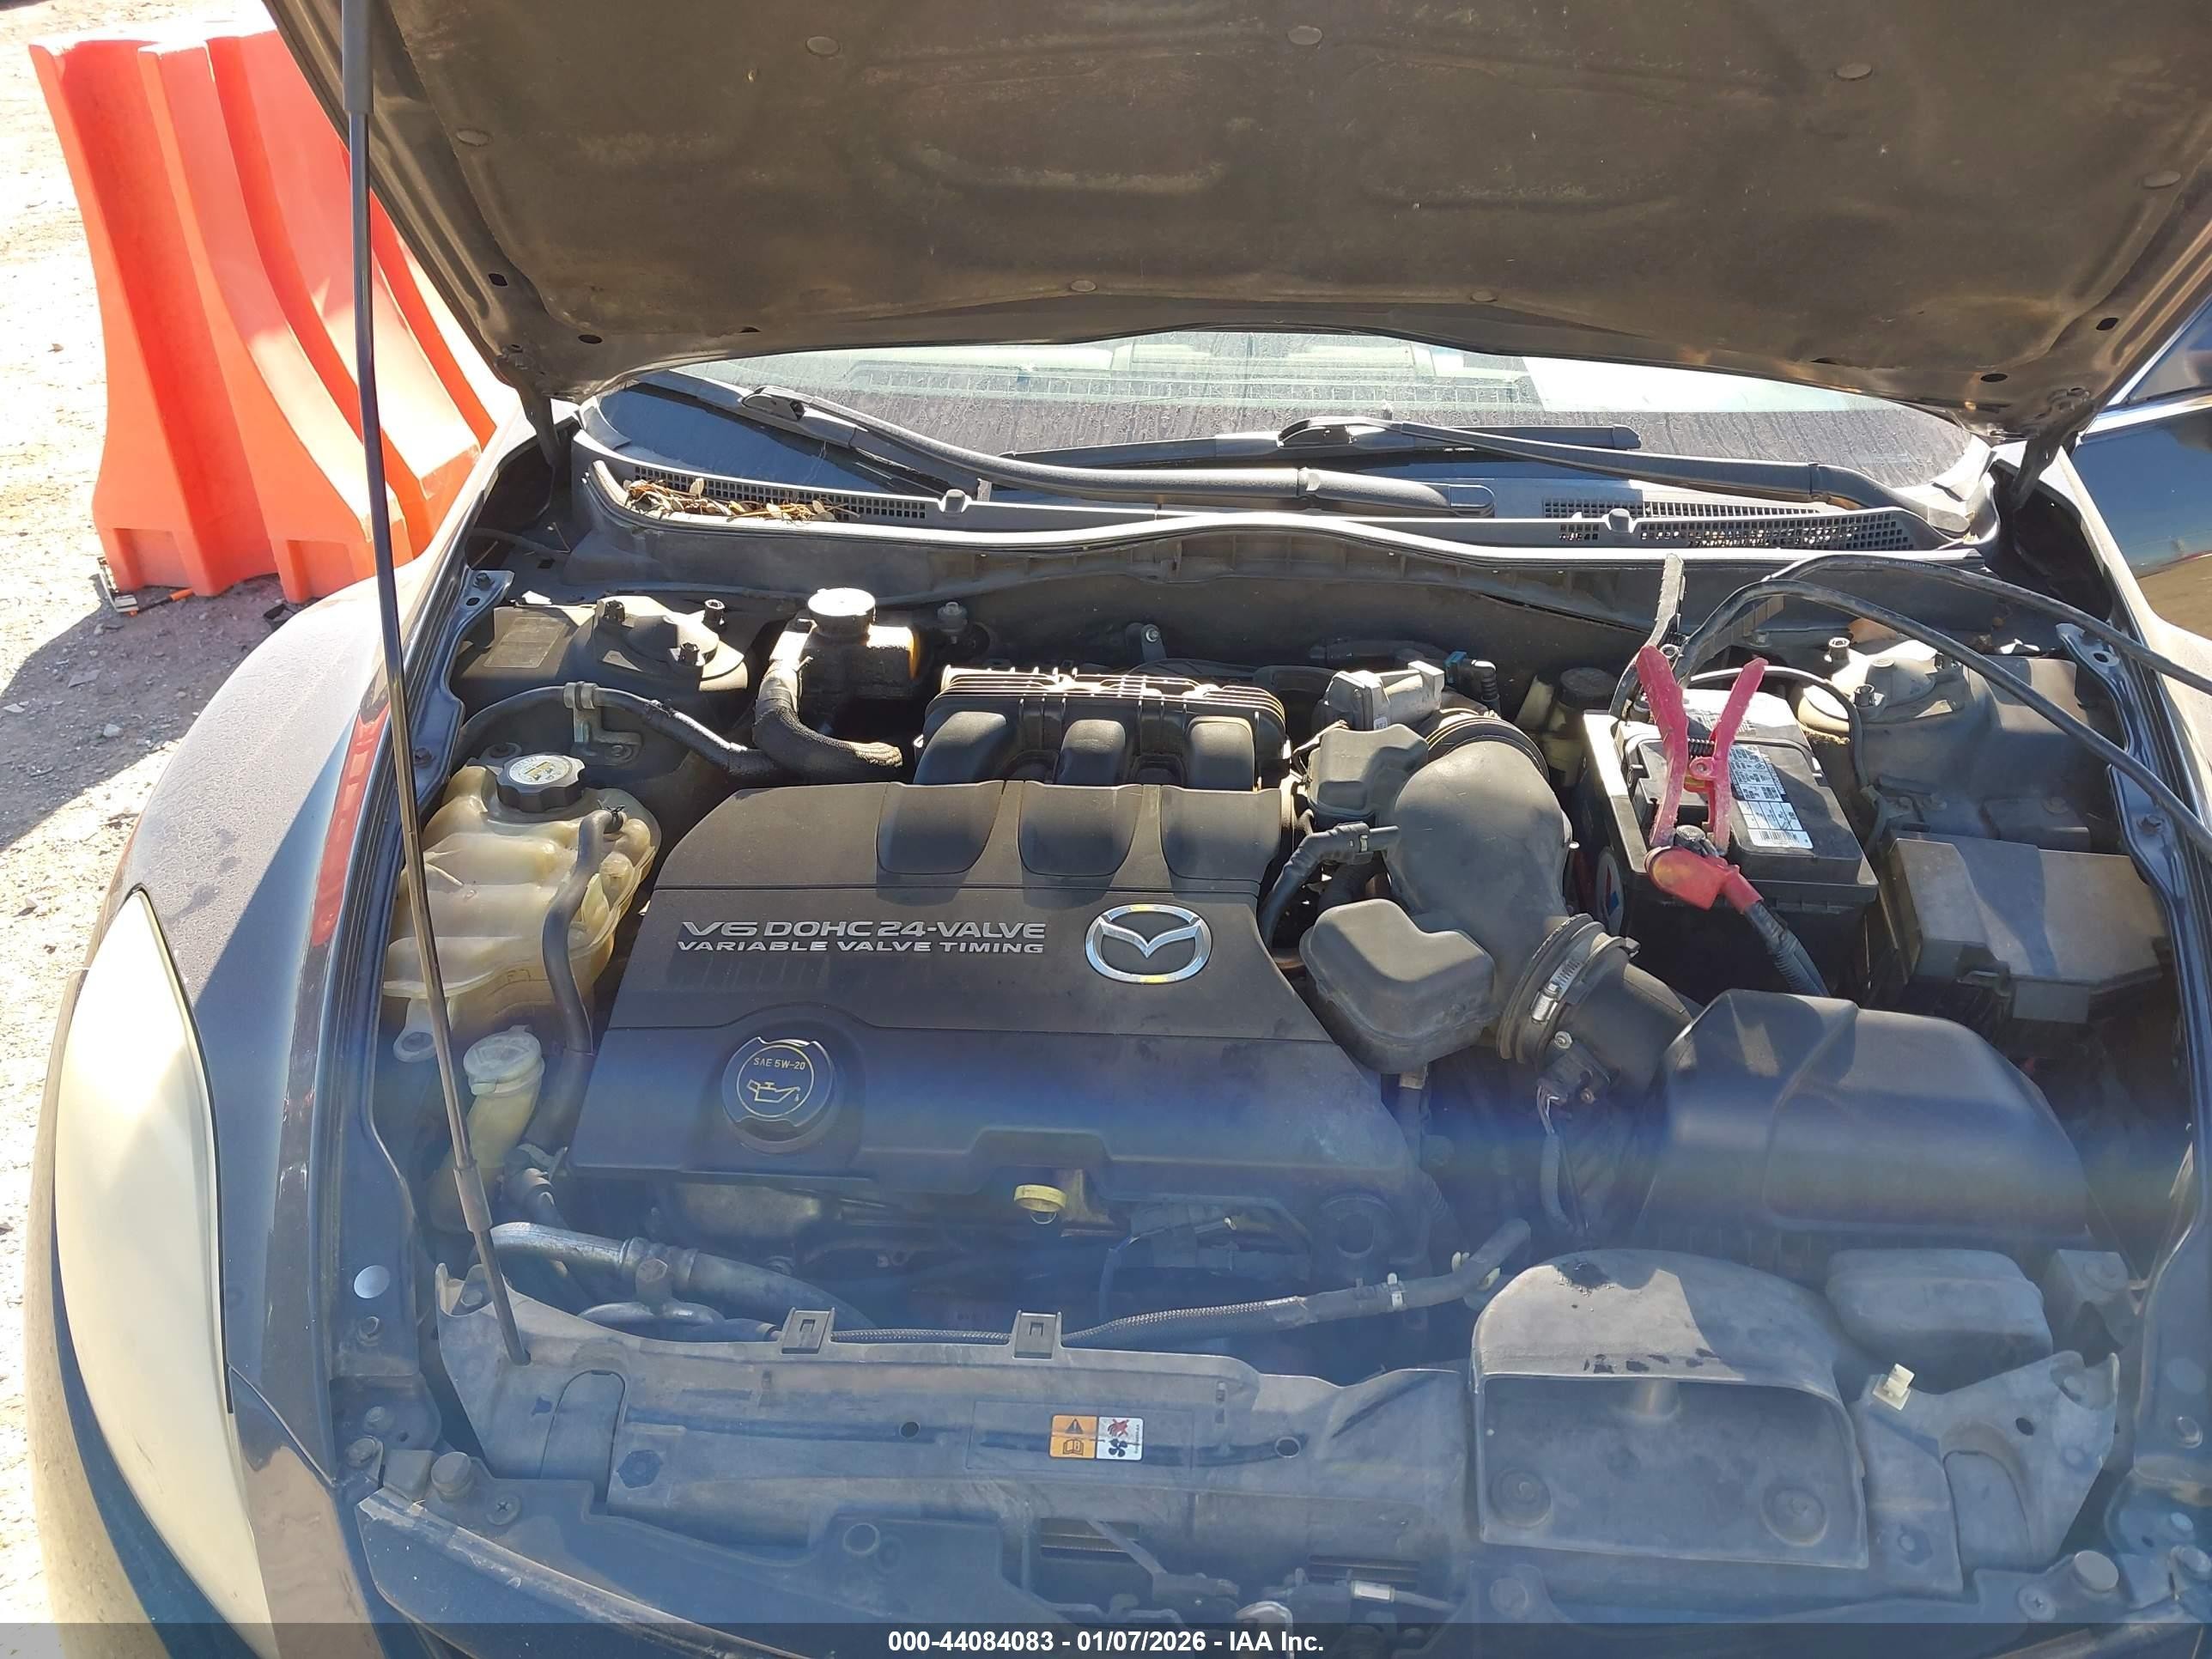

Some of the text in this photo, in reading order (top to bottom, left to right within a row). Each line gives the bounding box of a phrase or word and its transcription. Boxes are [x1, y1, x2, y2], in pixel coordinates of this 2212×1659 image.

[682, 921, 1046, 939] V6 DOHC 24-VALVE
[678, 941, 1044, 953] VARIABLE VALVE TIMING
[753, 1057, 806, 1070] SAE 5W-20
